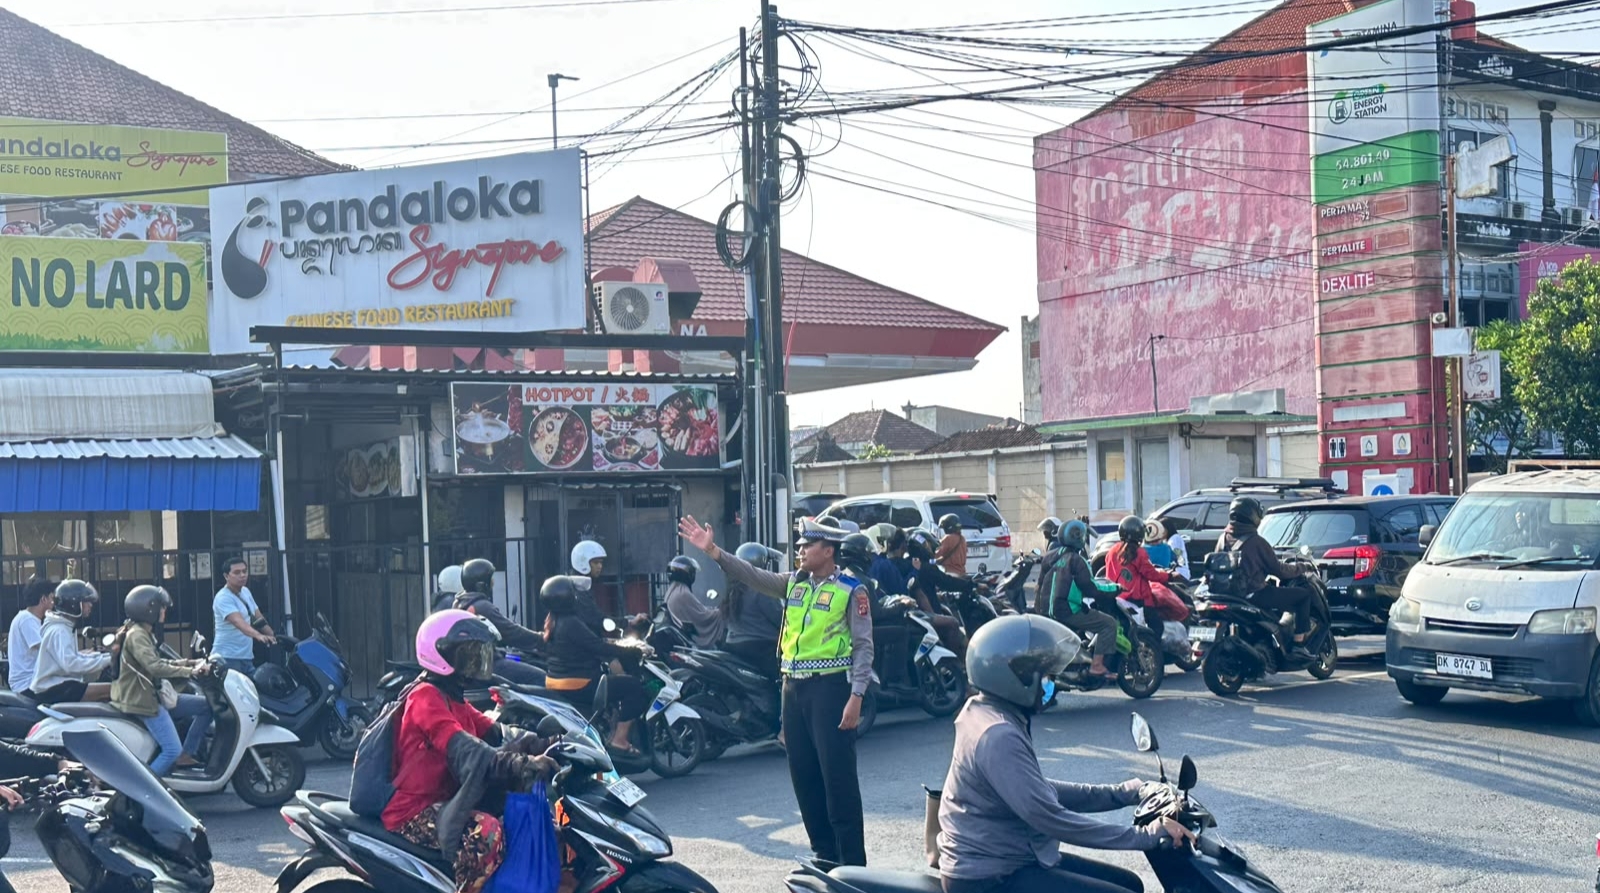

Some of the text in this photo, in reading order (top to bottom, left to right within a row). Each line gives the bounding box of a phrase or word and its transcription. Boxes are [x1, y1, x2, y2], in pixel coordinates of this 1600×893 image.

[1354, 95, 1384, 110] ENERGY
[1354, 103, 1387, 119] STATION
[127, 140, 218, 177] Signature
[23, 165, 51, 176] FOOD
[54, 168, 123, 181] RESTAURANT
[280, 174, 544, 238] Pandaloka
[1321, 200, 1370, 218] PERTAMAX
[1321, 240, 1366, 257] PERTALITE
[386, 224, 566, 298] Signature
[11, 257, 191, 312] NO LARD
[1321, 271, 1375, 294] DEXLITE
[356, 305, 400, 325] FOOD
[404, 298, 516, 323] RESTAURANT
[525, 387, 595, 403] HOTPOT
[1437, 655, 1449, 667] DK
[1453, 657, 1476, 670] 8747
[1480, 662, 1491, 673] DL
[606, 849, 633, 864] HONDA
